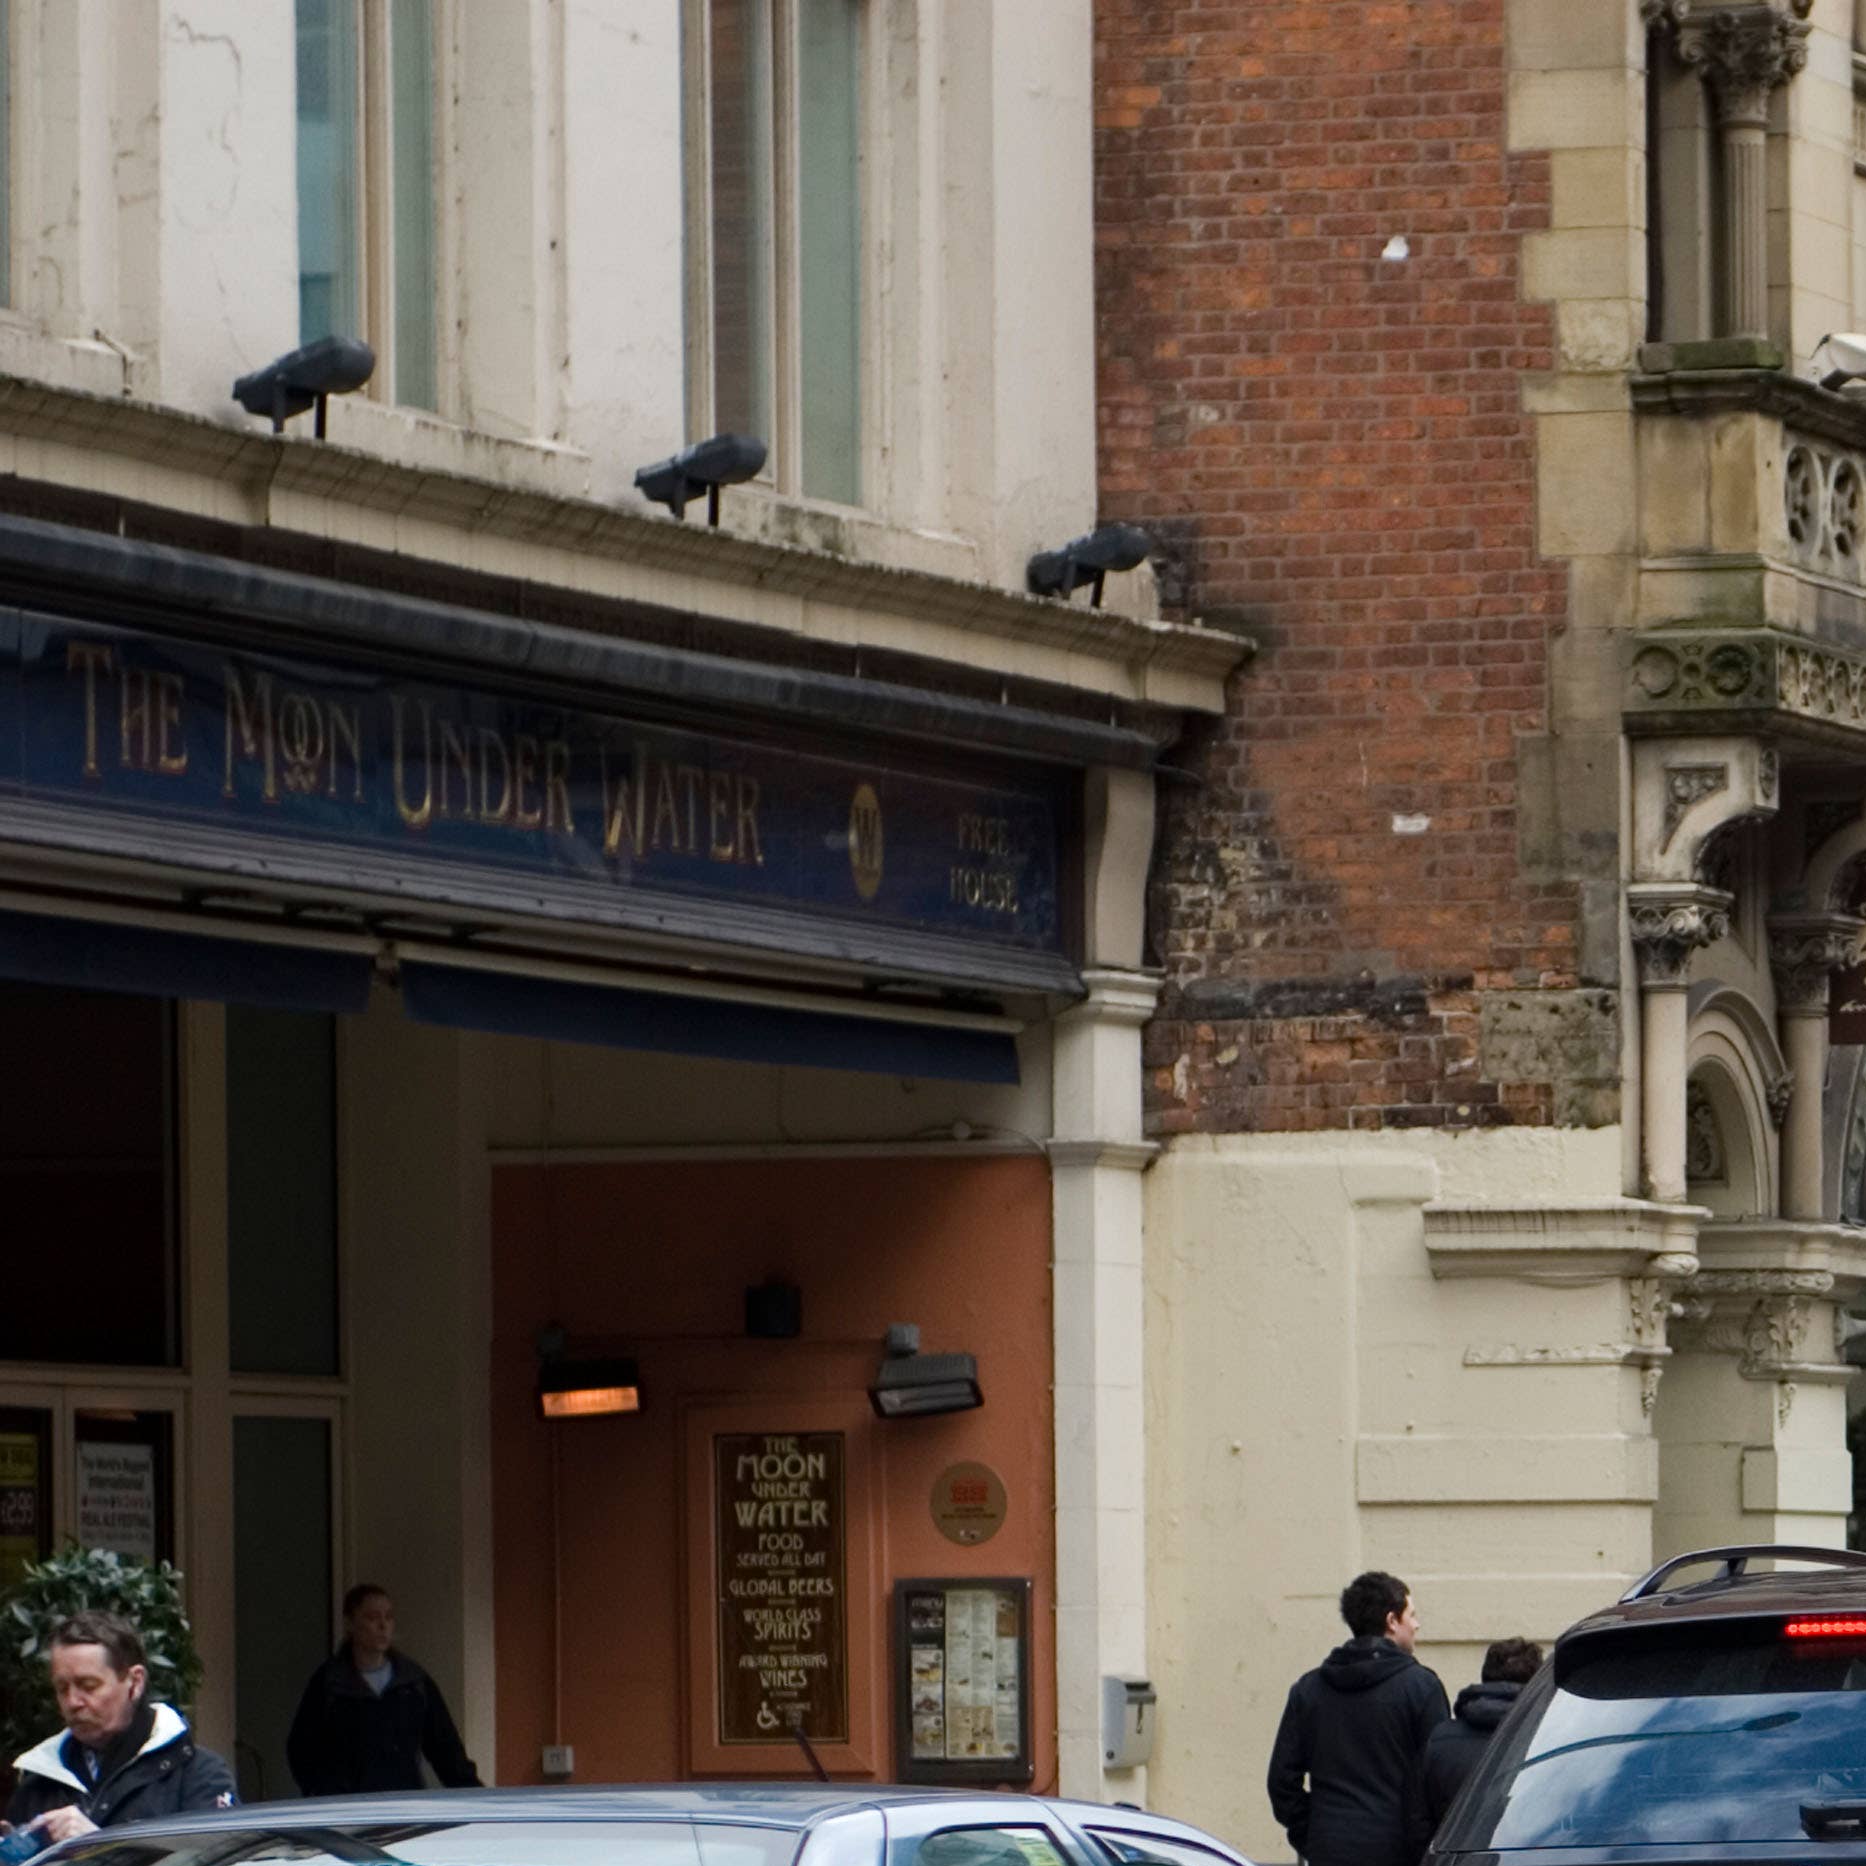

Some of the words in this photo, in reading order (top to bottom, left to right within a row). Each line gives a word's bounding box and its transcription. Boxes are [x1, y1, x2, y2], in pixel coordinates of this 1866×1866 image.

[737, 1454, 825, 1480] MOON
[752, 1481, 811, 1499] UNDER
[735, 1502, 828, 1528] WATER
[758, 1533, 804, 1550] FOOD
[729, 1579, 785, 1596] GLOBAL
[754, 1622, 812, 1640] SPIRITS
[759, 1670, 807, 1688] WINES
